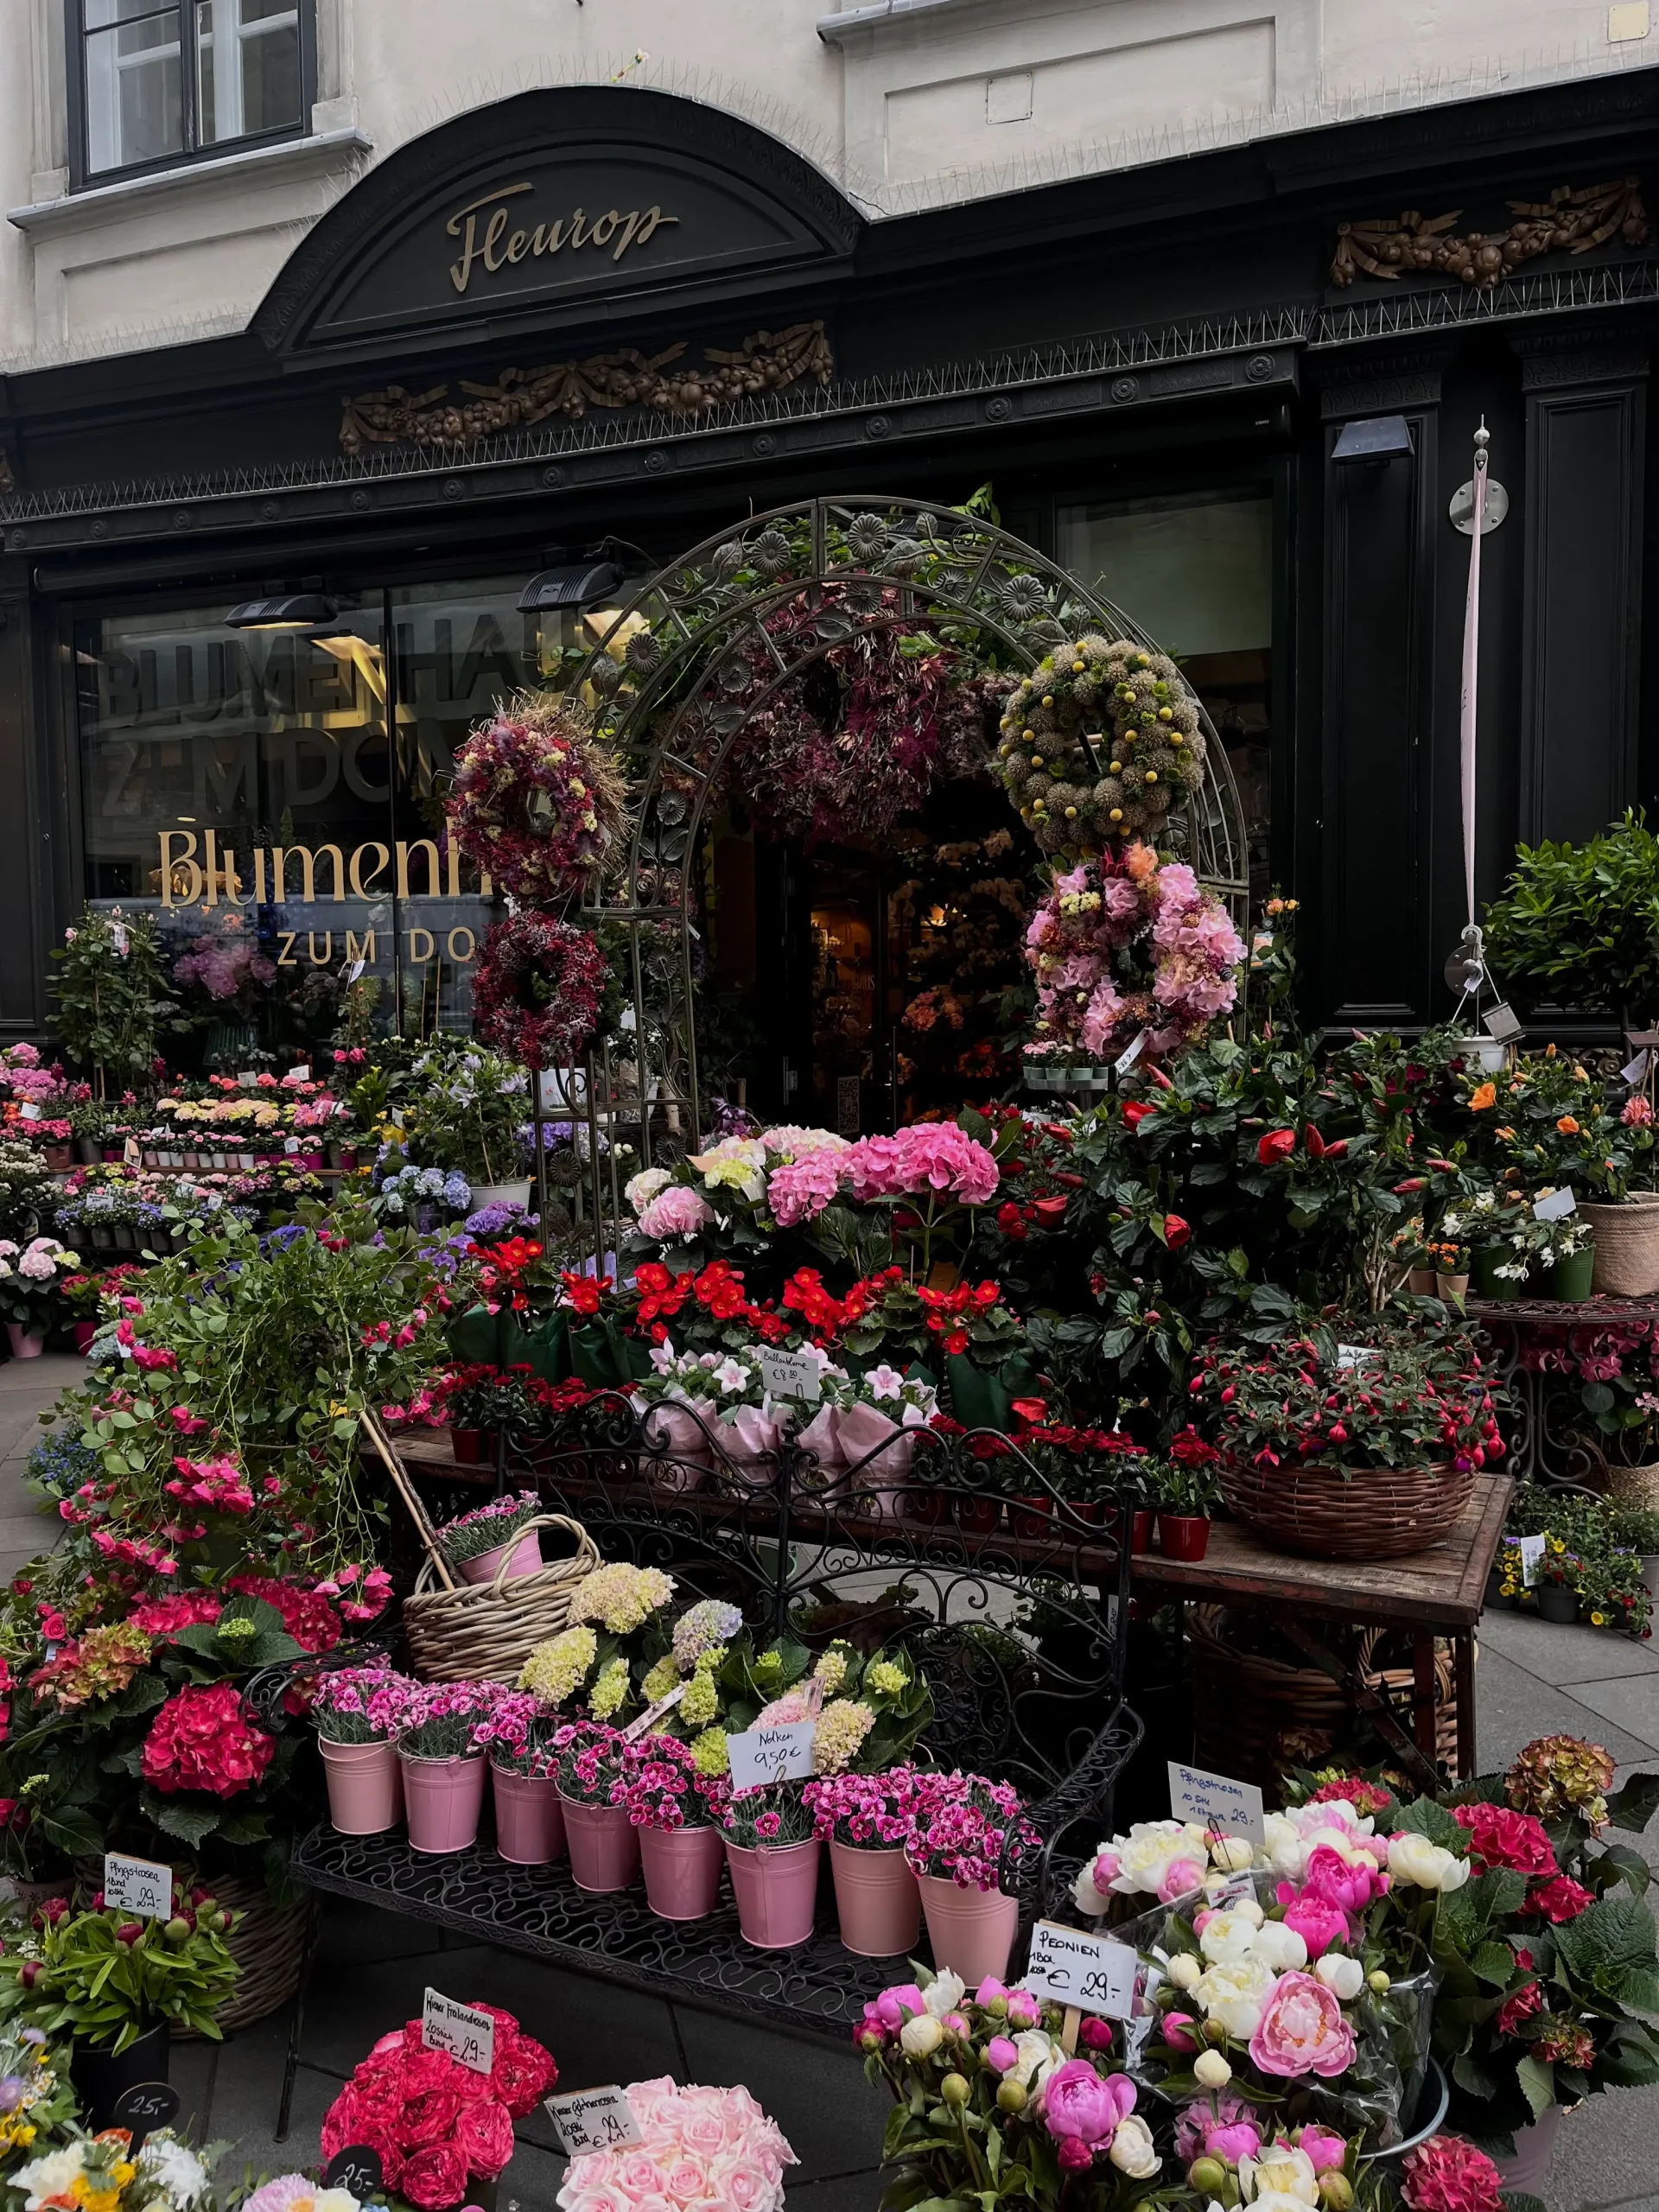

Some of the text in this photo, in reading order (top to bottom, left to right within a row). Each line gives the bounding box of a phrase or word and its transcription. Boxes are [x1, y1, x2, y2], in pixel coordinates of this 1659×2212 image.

[447, 181, 681, 292] Fleurop
[276, 929, 376, 966] ZUM
[760, 1731, 793, 1746] Nelken
[1179, 1769, 1243, 1798] Pfingstrosen
[119, 1897, 133, 1907] €
[1039, 1930, 1100, 1959] PEONIEN
[1046, 1969, 1071, 1989] €
[449, 2044, 460, 2057] €
[592, 2135, 607, 2148] €
